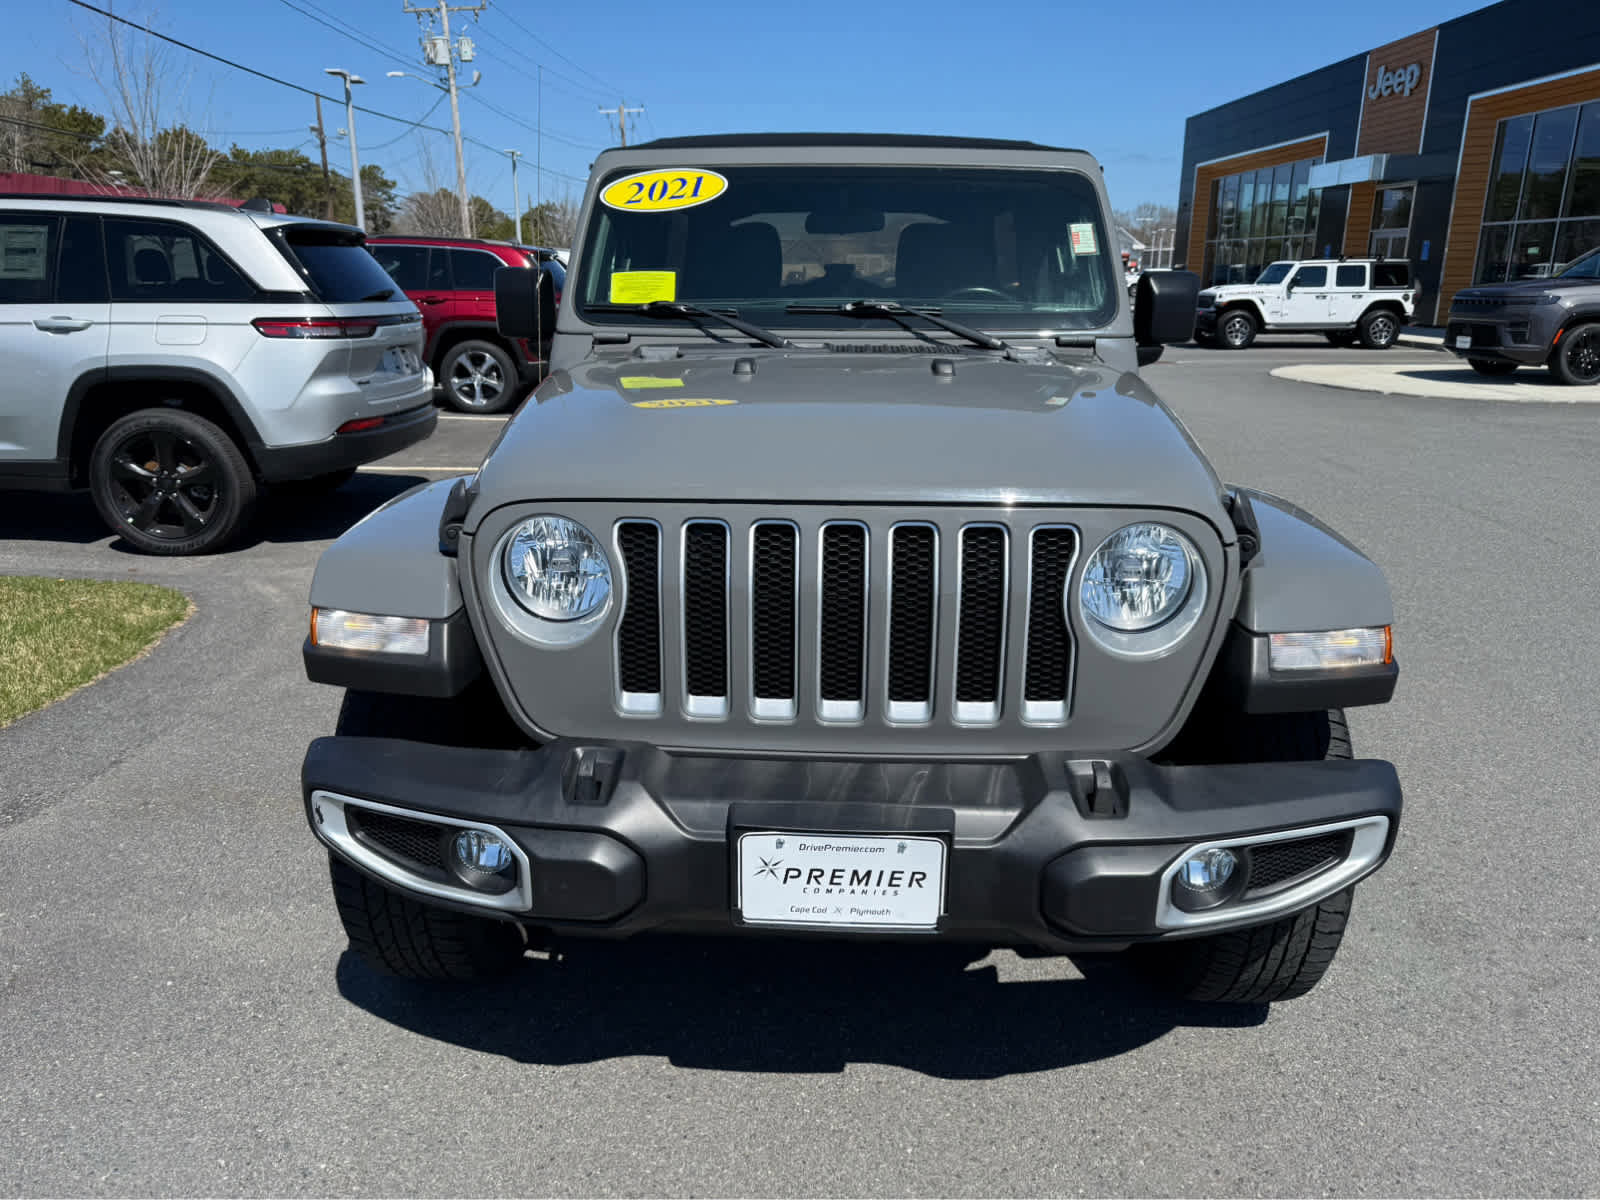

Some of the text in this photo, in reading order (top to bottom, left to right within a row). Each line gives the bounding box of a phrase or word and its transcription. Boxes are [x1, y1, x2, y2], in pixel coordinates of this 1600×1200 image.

[1368, 64, 1421, 100] Jeep
[624, 176, 704, 205] 2021
[799, 843, 885, 853] DrivePremier.com
[782, 867, 927, 888] PREMIER
[802, 887, 900, 896] COMPANIES
[790, 905, 828, 914] Cape Cod
[850, 907, 892, 916] Plymouth
